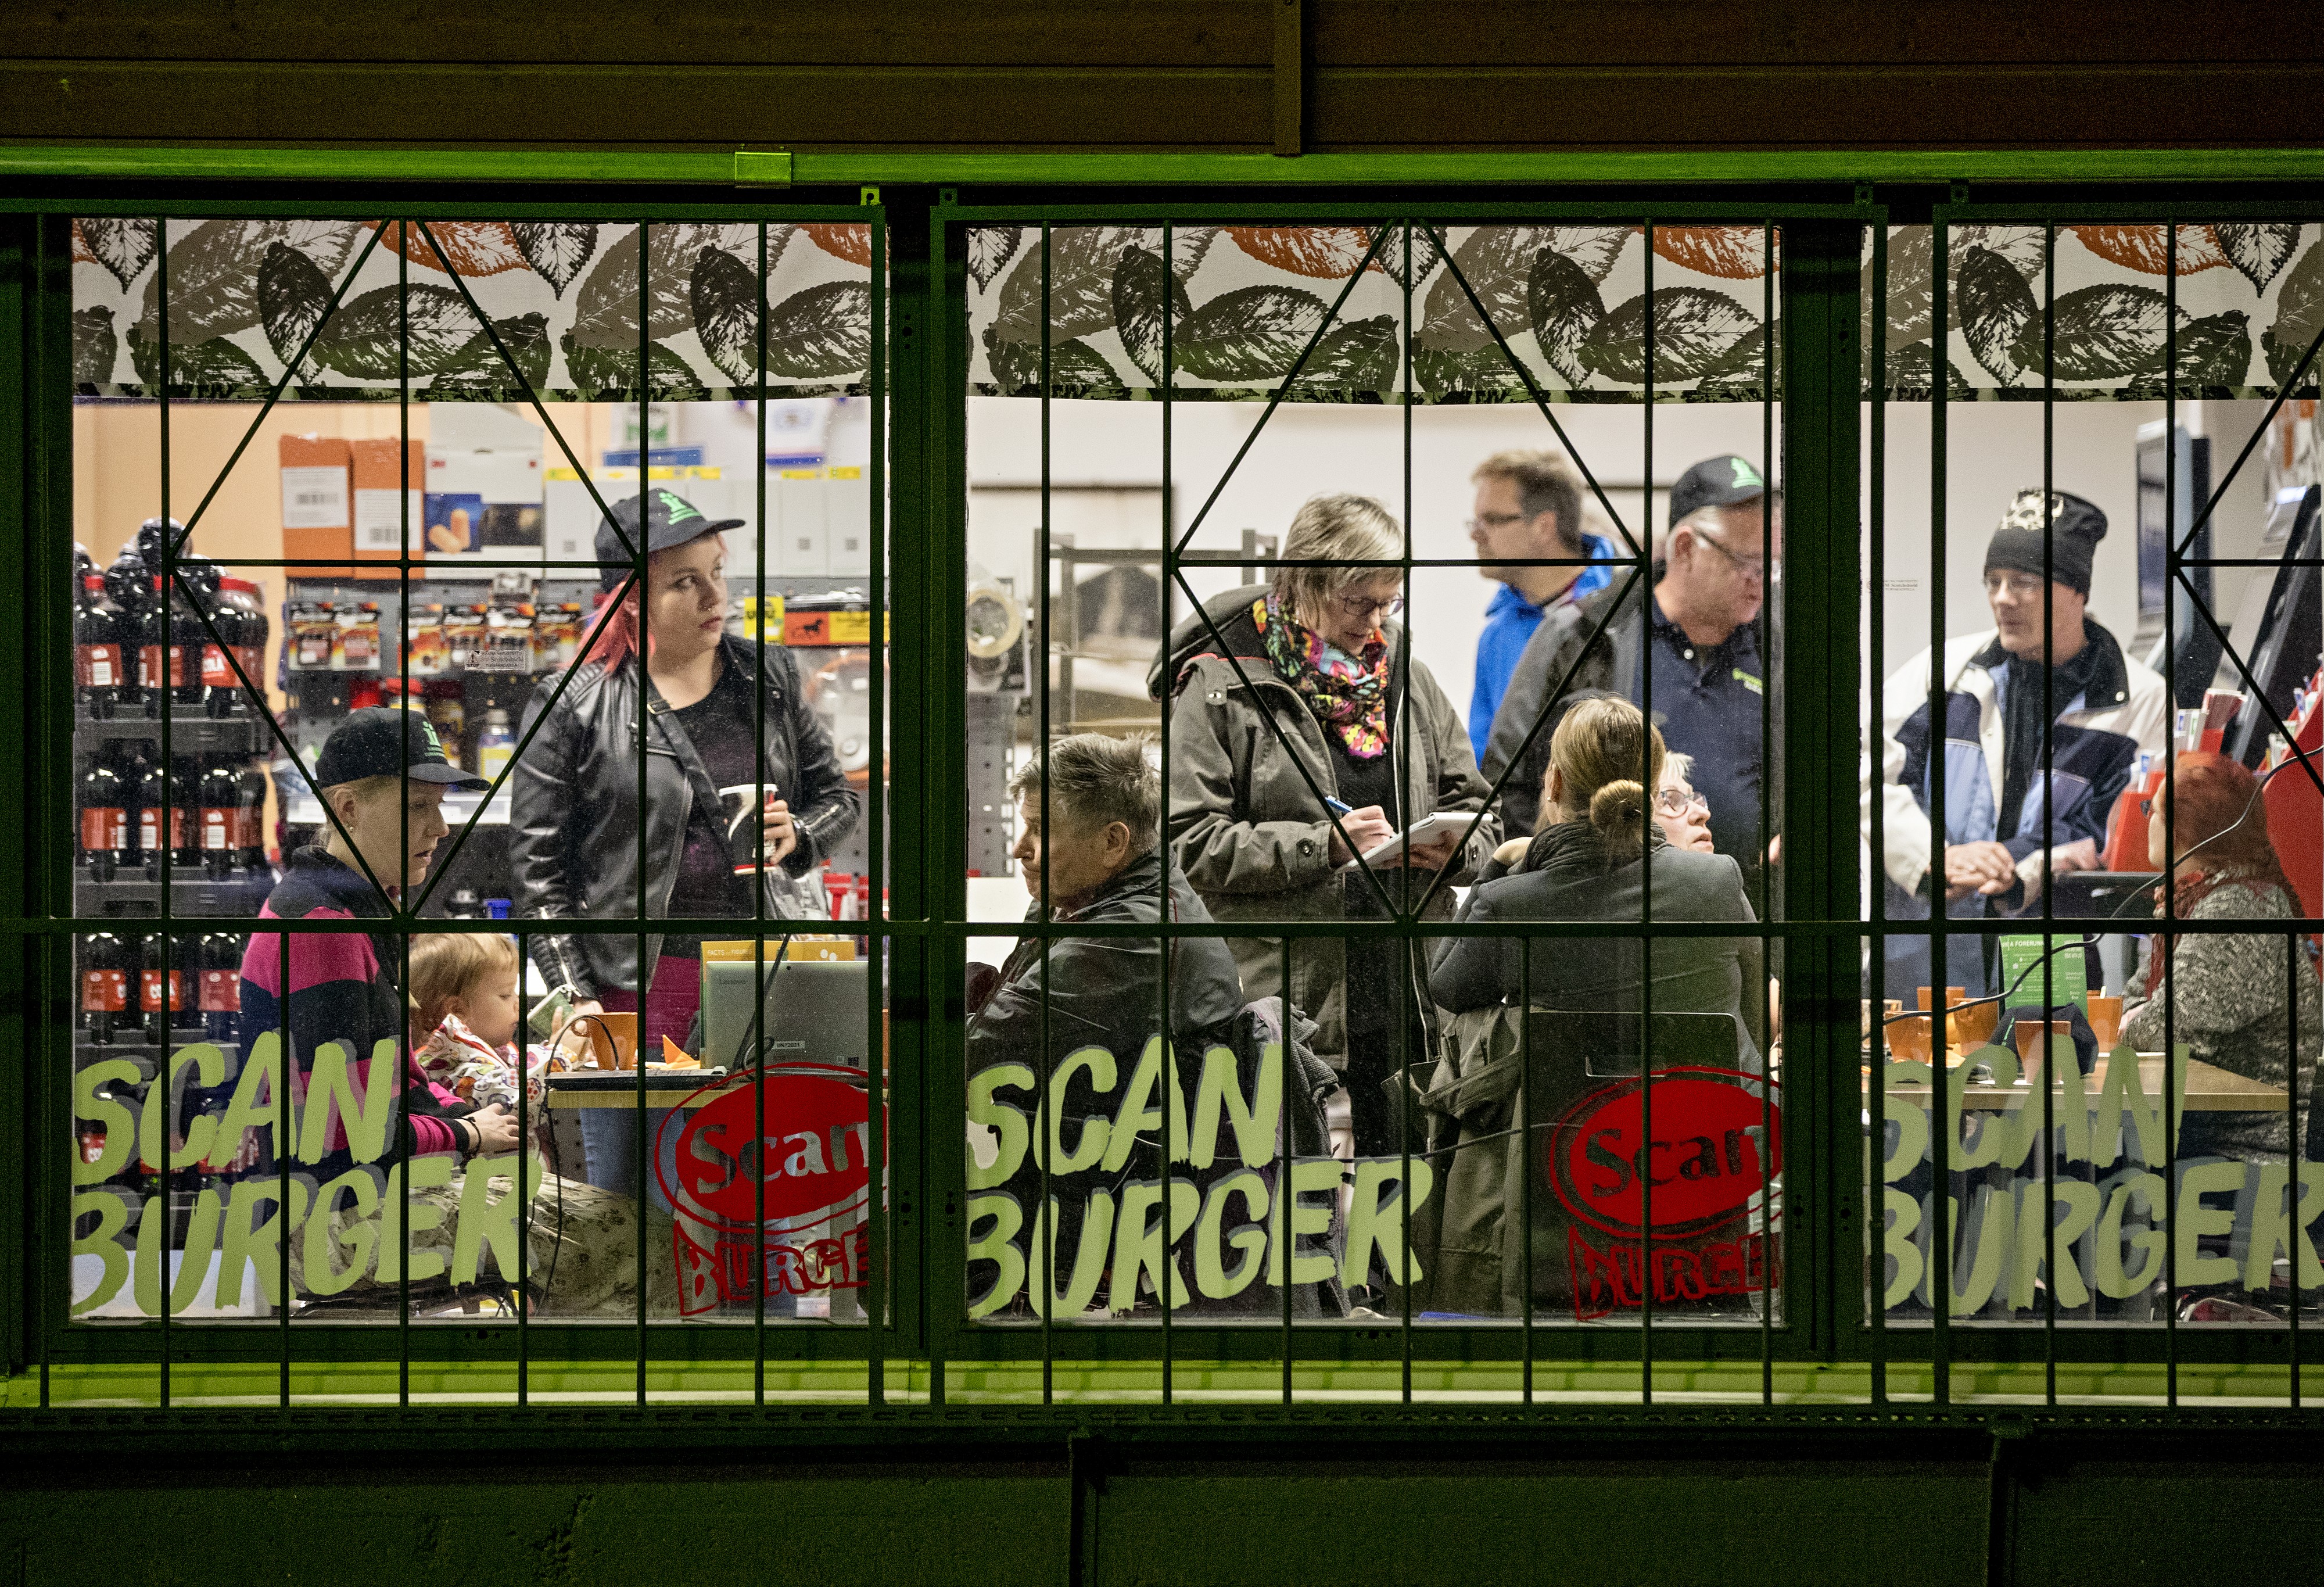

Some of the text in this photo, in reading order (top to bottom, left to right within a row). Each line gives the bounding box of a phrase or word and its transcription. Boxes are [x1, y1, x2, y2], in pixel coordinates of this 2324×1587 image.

[72, 1031, 401, 1185] SCAN
[690, 1120, 870, 1194] Scan
[966, 1033, 1283, 1190] SCAN
[1584, 1124, 1773, 1198] Scan
[1863, 1033, 2189, 1183] SCAN
[71, 1155, 543, 1316] BURGER
[966, 1156, 1433, 1319] BURGER
[1863, 1161, 2324, 1317] BURGER
